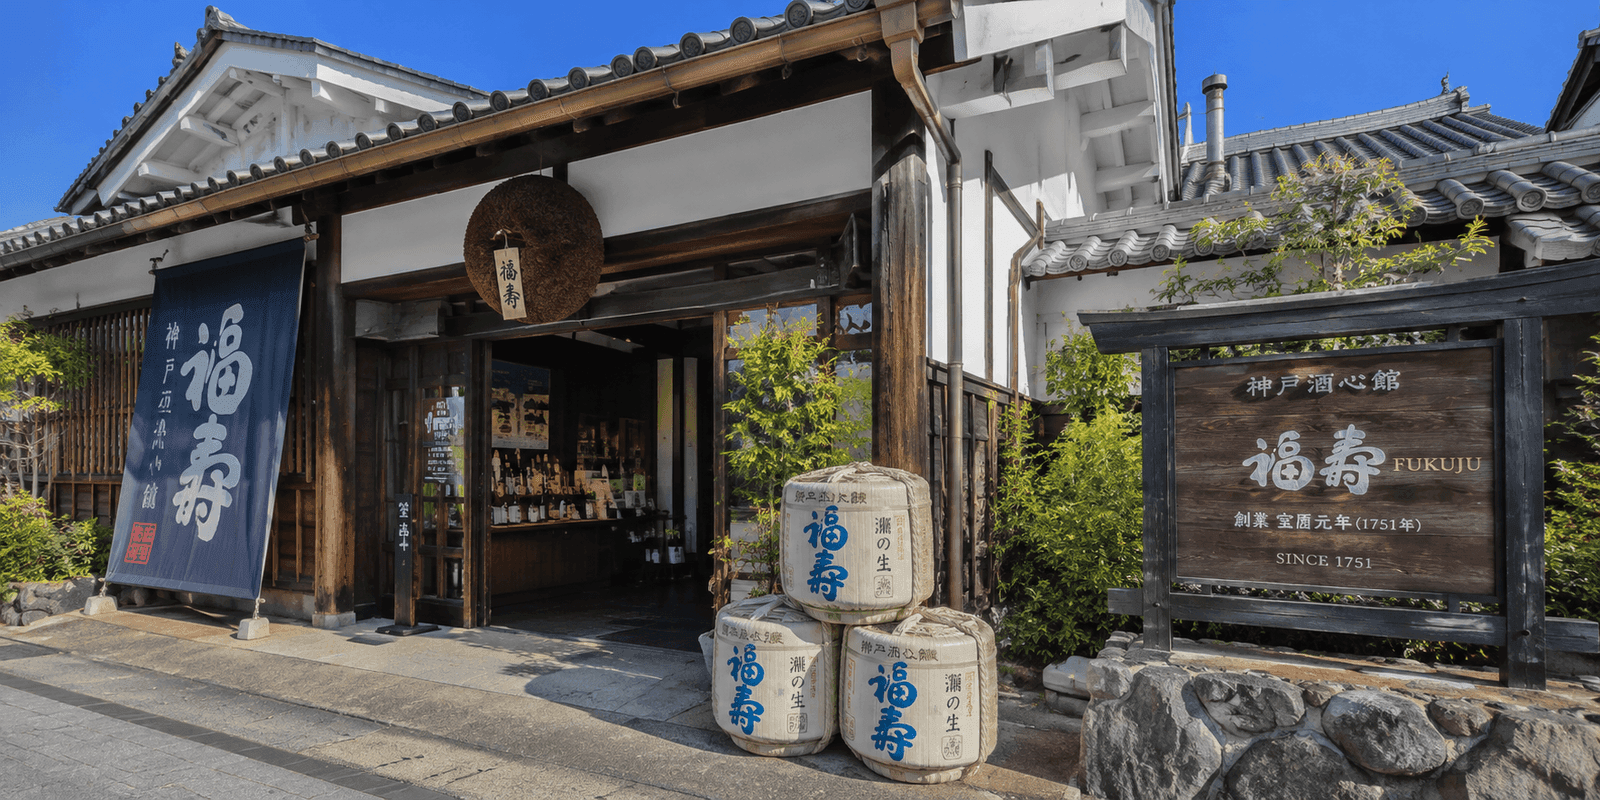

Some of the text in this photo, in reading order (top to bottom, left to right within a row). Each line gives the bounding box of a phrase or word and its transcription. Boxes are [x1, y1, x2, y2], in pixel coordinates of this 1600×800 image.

[500, 259, 520, 309] 福寿
[1246, 369, 1400, 398] 神戸酒心館
[172, 303, 253, 542] 福寿
[1242, 423, 1482, 496] 福寿 FUKUJU
[803, 505, 849, 602] 福寿
[1233, 511, 1269, 529] 創業
[1276, 553, 1372, 569] SINCE 1751
[727, 643, 765, 735] 福寿
[868, 661, 918, 761] 福寿
